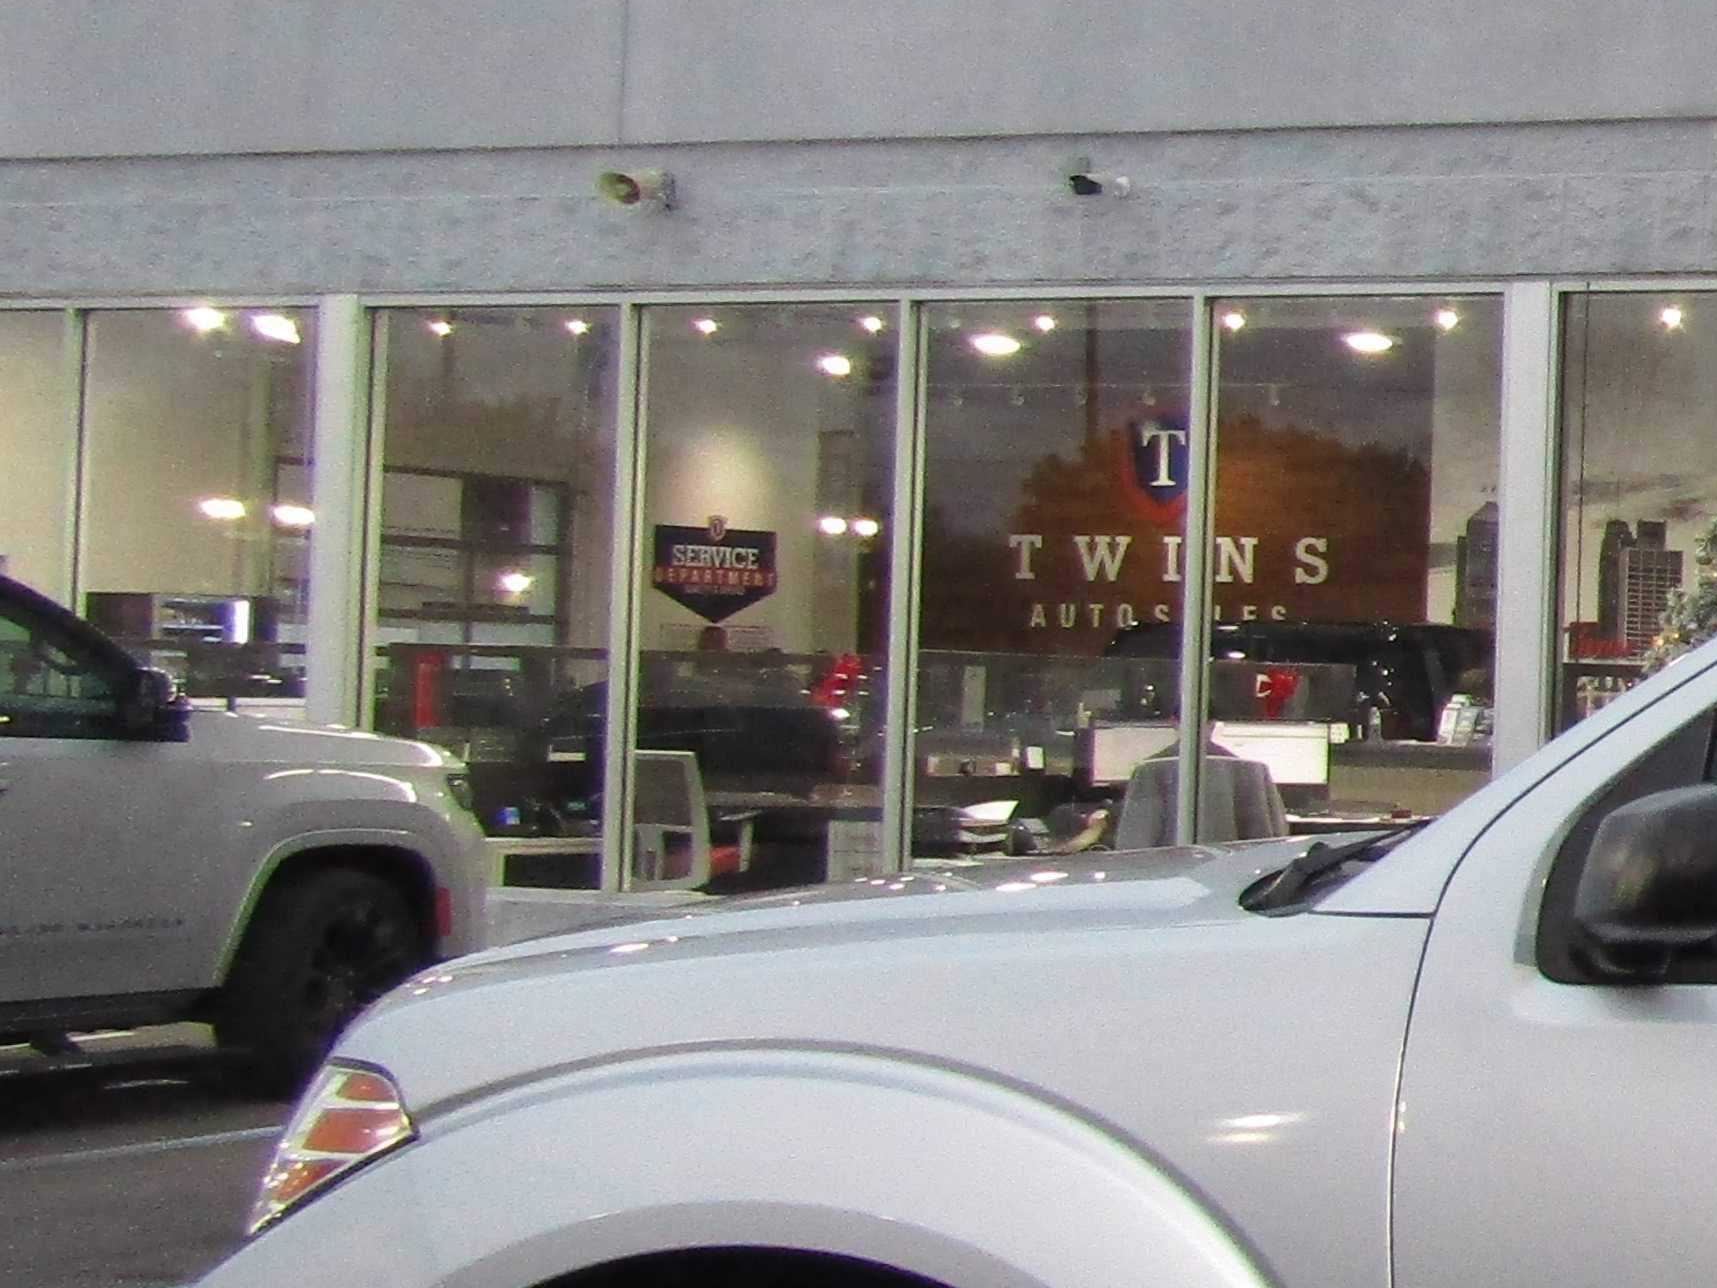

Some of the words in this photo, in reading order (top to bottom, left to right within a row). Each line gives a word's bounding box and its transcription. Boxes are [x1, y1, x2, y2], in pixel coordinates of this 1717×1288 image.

[1142, 429, 1186, 487] T
[672, 544, 759, 569] SERVICE
[1008, 534, 1329, 585] TWINS
[655, 567, 776, 587] DEPARTMENT
[1030, 604, 1135, 629] AUTO
